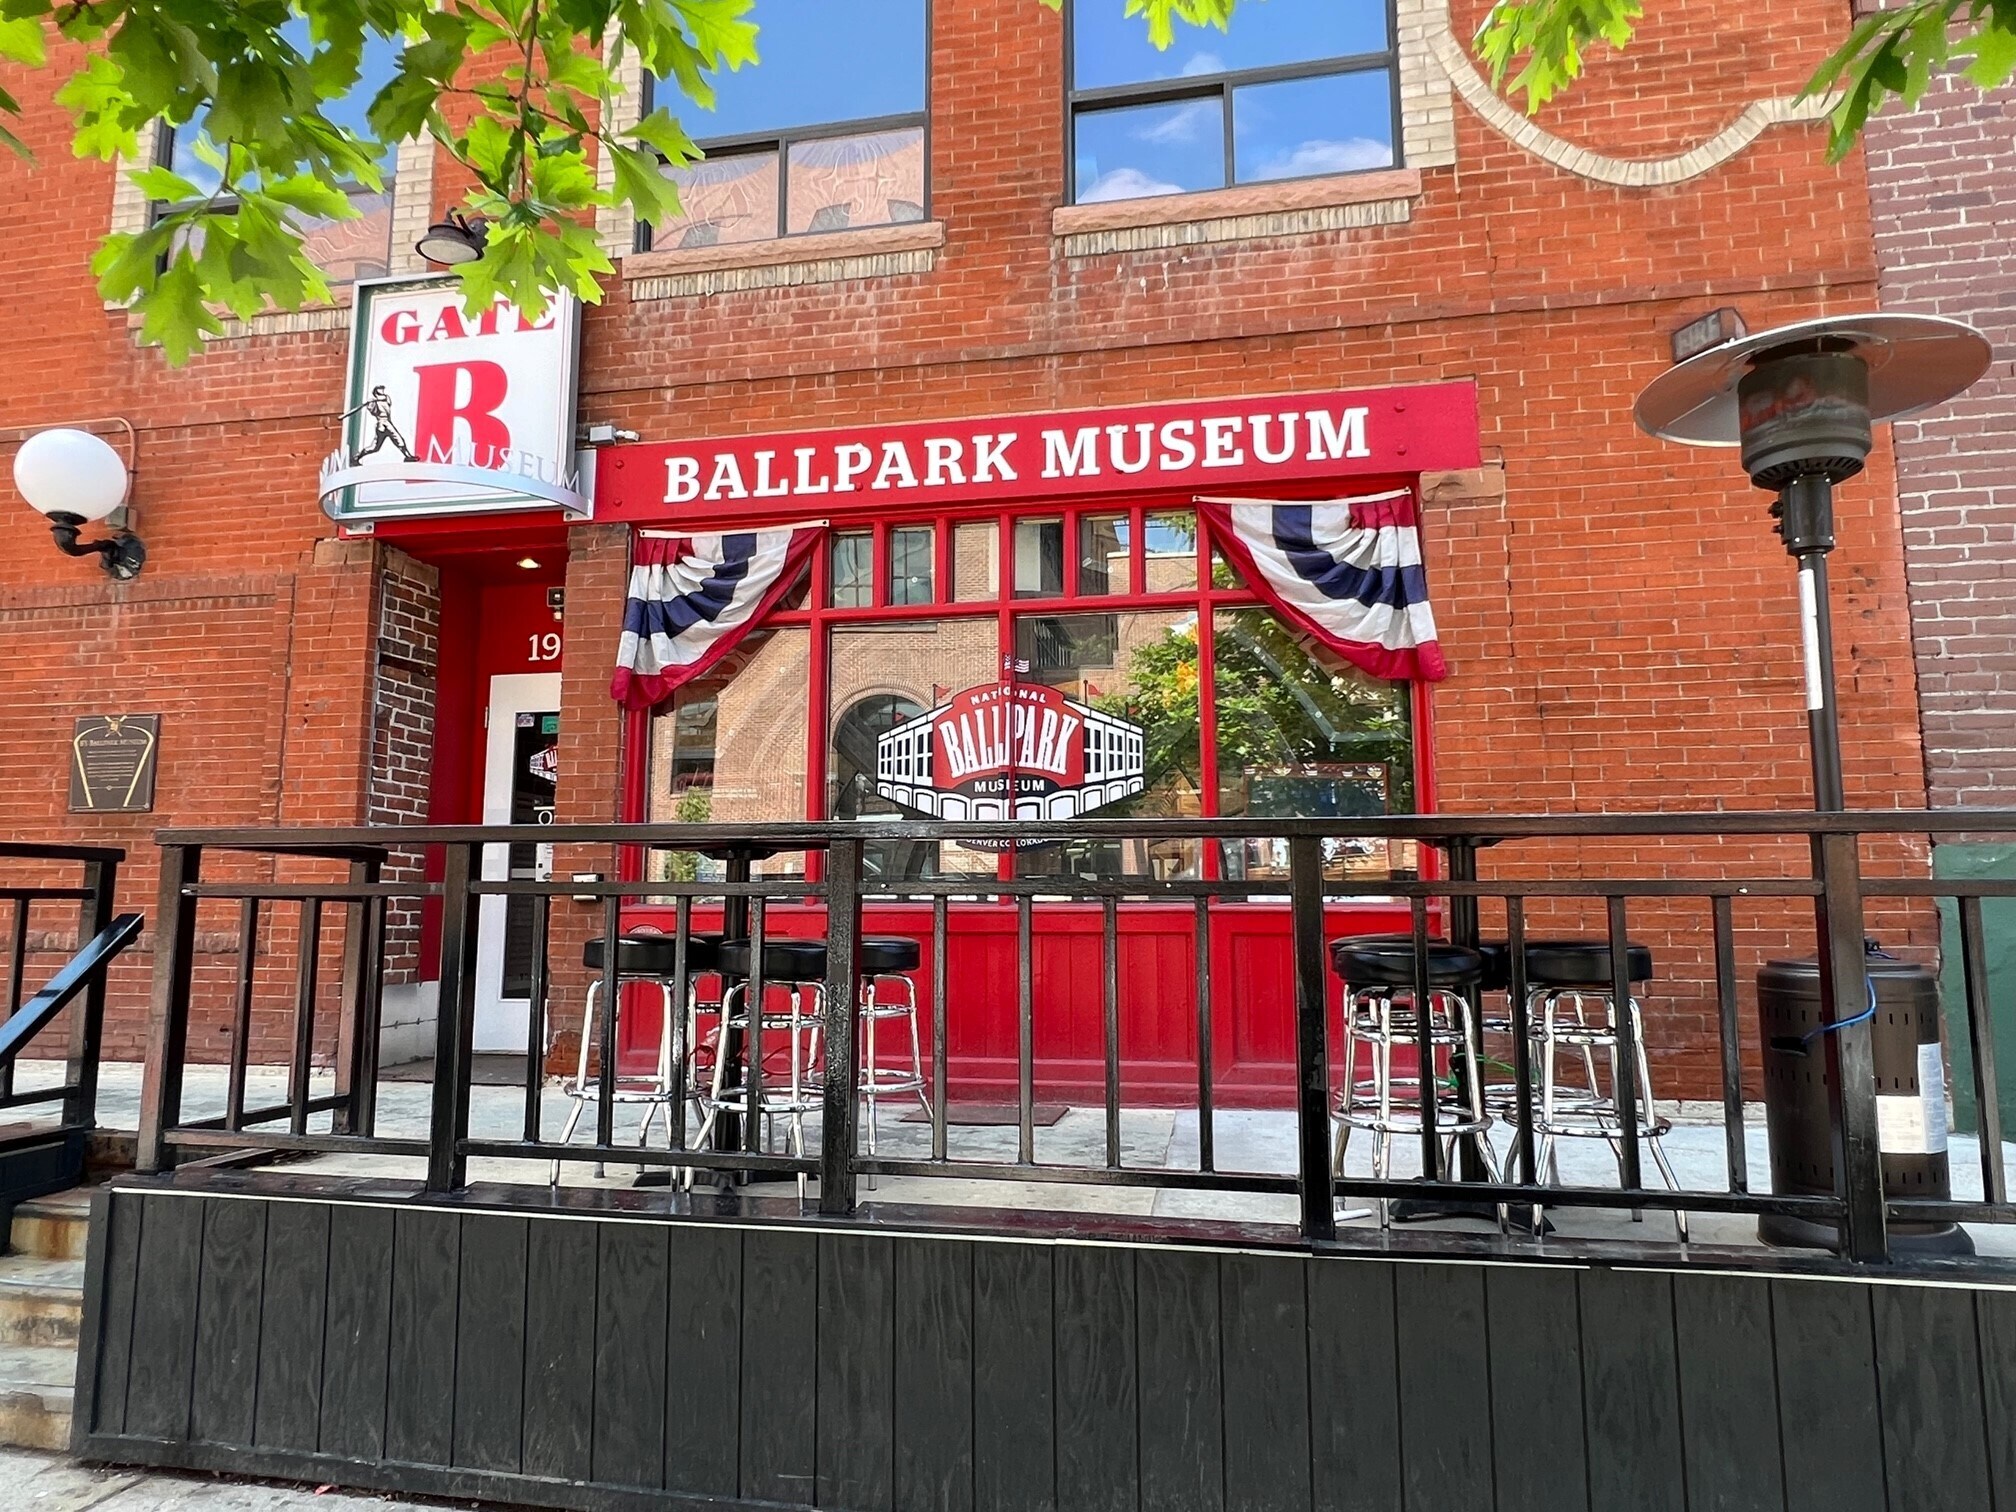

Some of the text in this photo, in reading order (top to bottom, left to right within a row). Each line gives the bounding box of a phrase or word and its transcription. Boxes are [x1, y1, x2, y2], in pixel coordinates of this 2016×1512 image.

[426, 433, 581, 496] MUSEUM
[663, 406, 1371, 503] BALLPARK MUSEUM
[528, 632, 561, 661] 19
[970, 686, 1046, 706] NATIONAL
[938, 701, 1080, 779] BALLPARK
[974, 778, 1045, 793] MUSEUM
